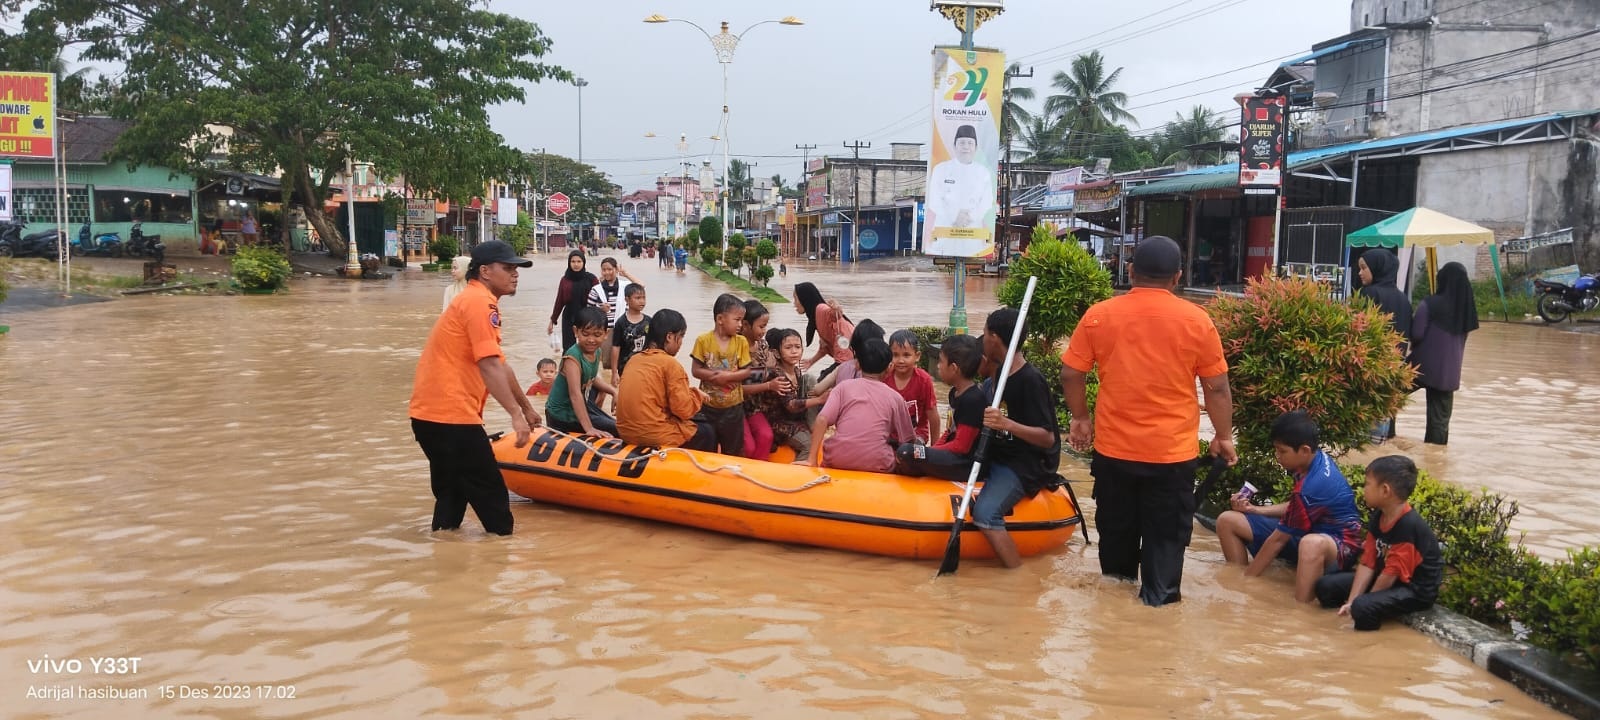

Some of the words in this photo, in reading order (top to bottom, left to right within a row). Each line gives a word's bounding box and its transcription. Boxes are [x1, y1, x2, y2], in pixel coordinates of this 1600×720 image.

[942, 108, 967, 116] ROKAN
[1249, 123, 1276, 131] DJARUM
[526, 430, 661, 479] BNPB
